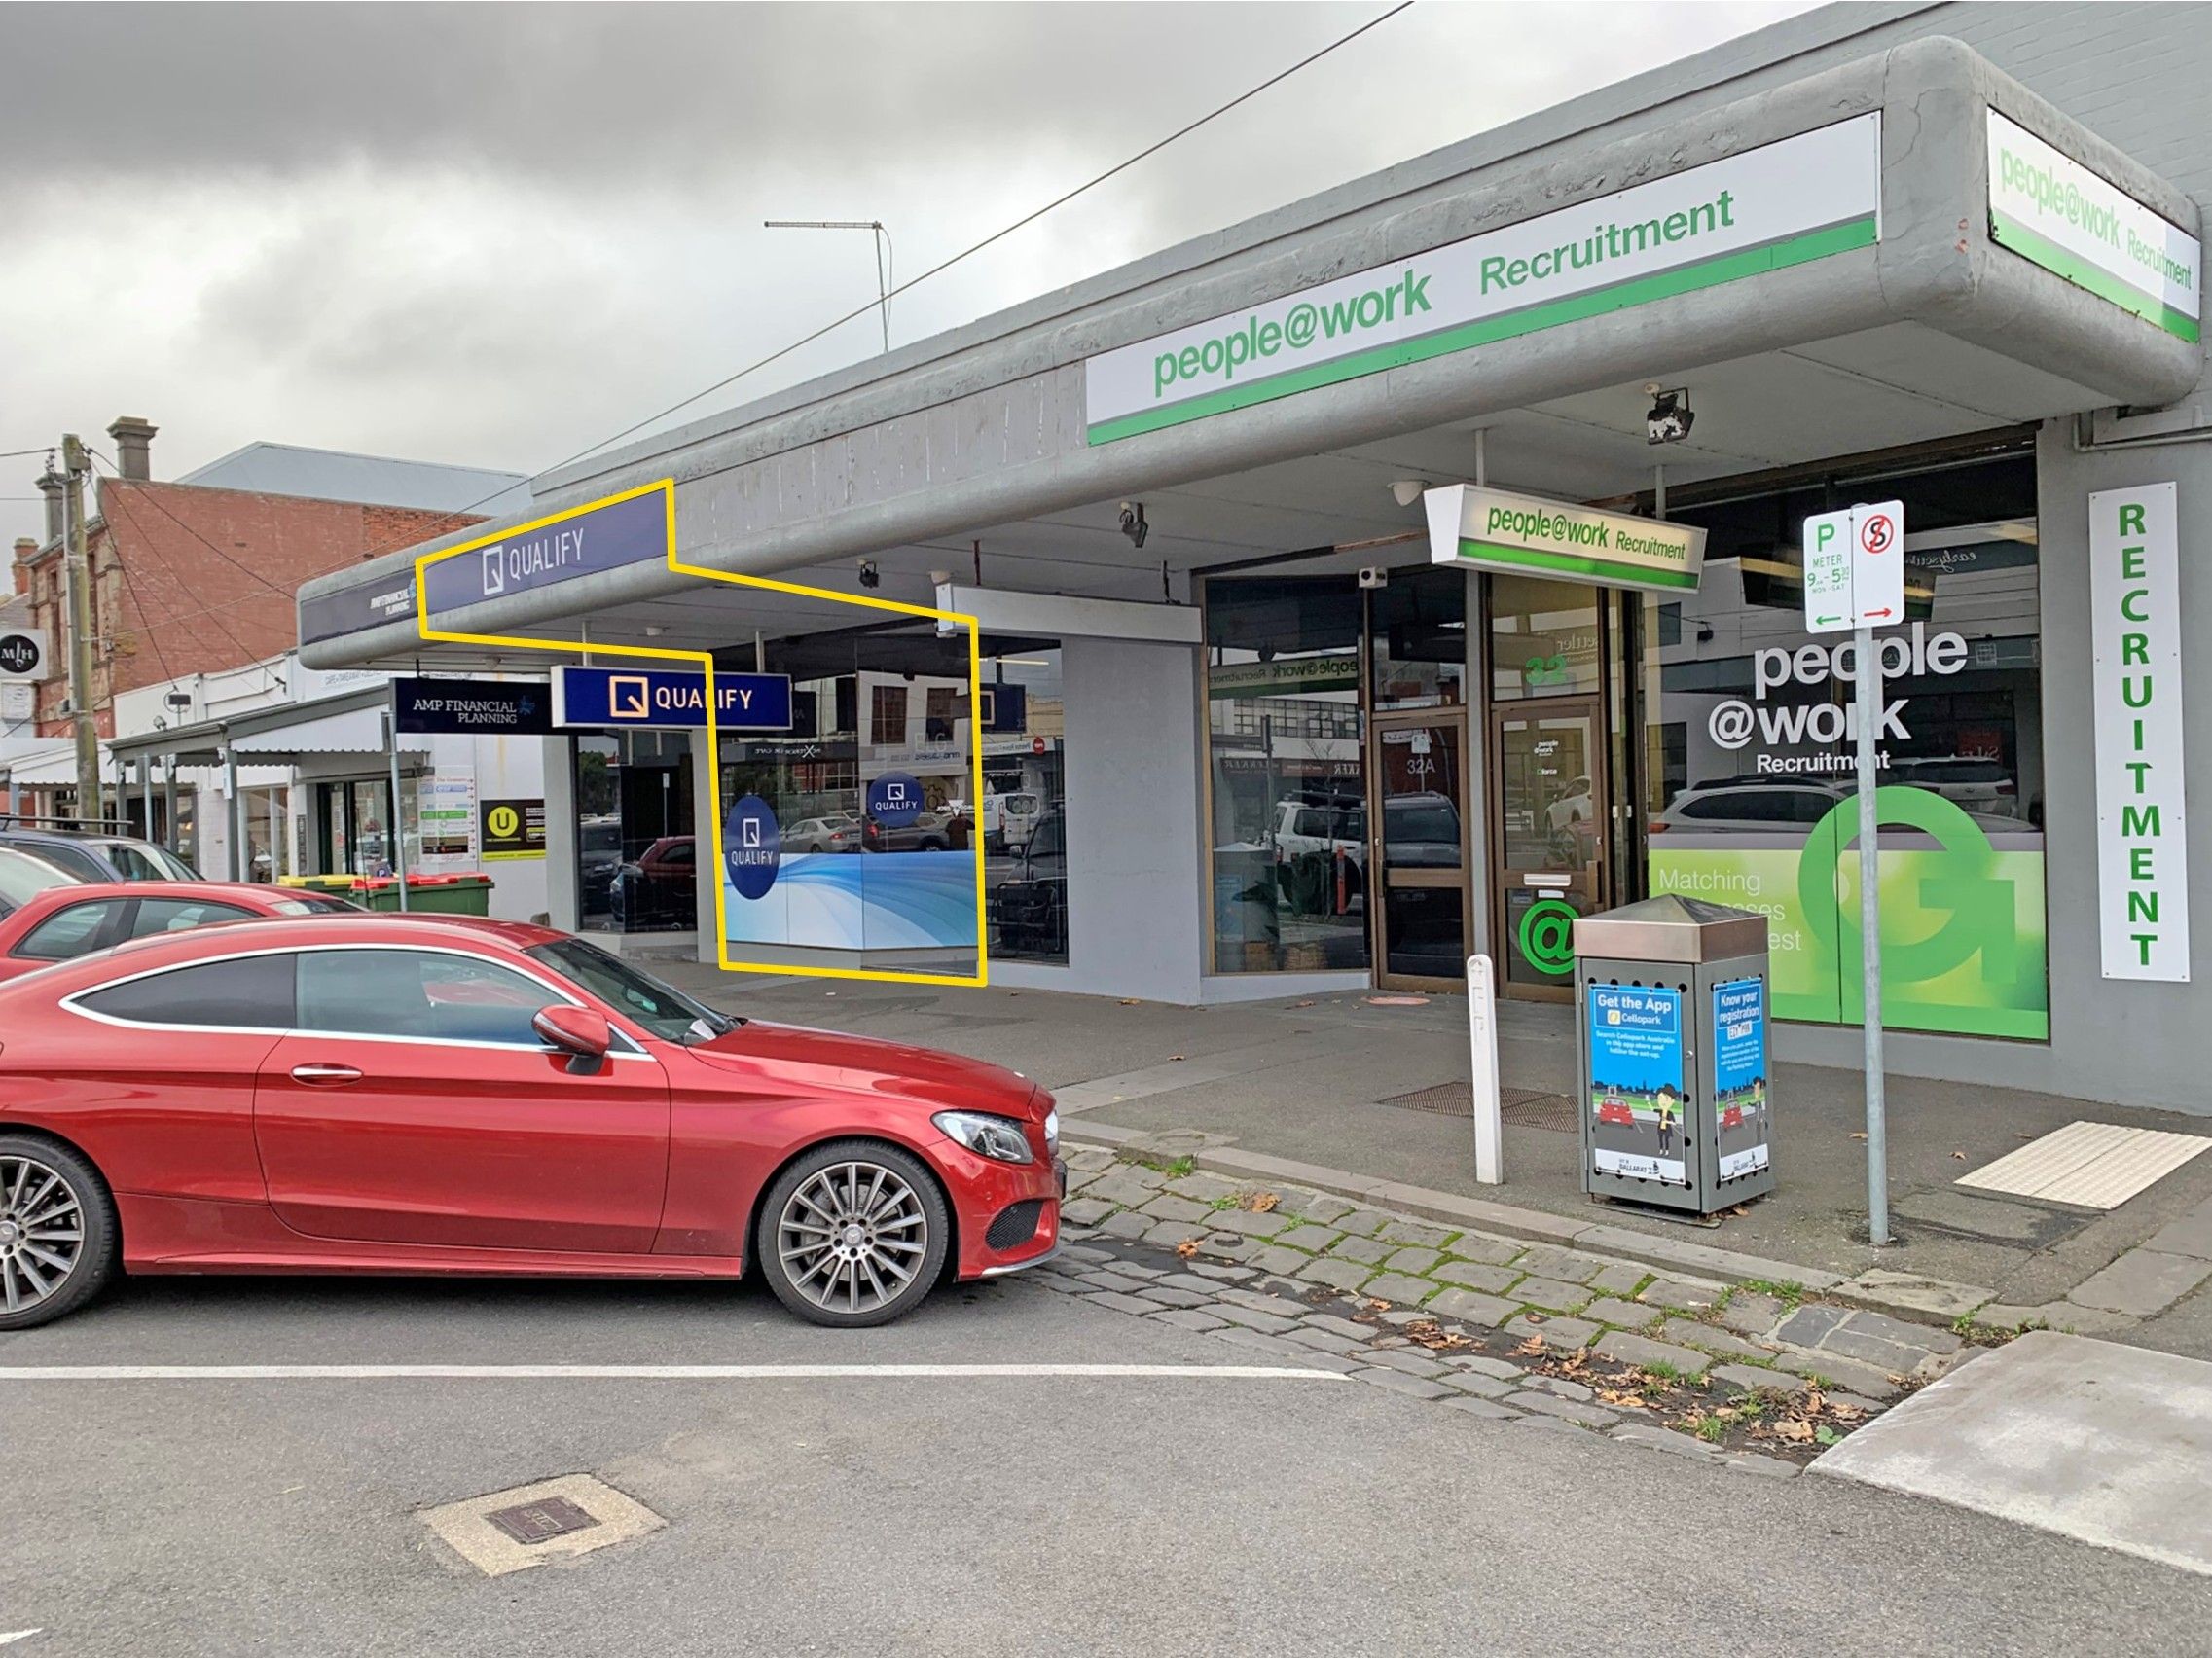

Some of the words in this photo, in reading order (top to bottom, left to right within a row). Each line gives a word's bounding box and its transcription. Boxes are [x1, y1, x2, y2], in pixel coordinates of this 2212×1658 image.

[1999, 148, 2121, 249] people@work
[2126, 228, 2192, 290] Recruitment
[1154, 268, 1432, 397] people@work
[1479, 190, 1735, 295] Recruitment
[1487, 505, 1611, 548] people@work
[1615, 530, 1686, 559] Recruitment
[1817, 523, 1835, 552] P
[508, 527, 585, 581] QUALIFY
[1812, 554, 1842, 568] METER
[1525, 654, 1568, 685] 32
[1754, 621, 1969, 700] people
[413, 699, 444, 711] AMP
[445, 700, 517, 713] FINANCIAL
[655, 686, 753, 710] QUAIFY
[457, 713, 518, 724] PLANNING
[2118, 502, 2161, 967] RECRUITMENT
[1406, 758, 1435, 775] 32A
[1756, 749, 1891, 773] Recruitmnt
[875, 800, 918, 811] QUALIFY
[731, 850, 774, 866] QUALIFY
[1658, 868, 1761, 896] Matching
[1768, 930, 1802, 951] est
[1597, 994, 1619, 1008] Get
[1621, 996, 1643, 1009] the
[1645, 997, 1672, 1014] App
[1720, 993, 1741, 1008] Know
[1742, 992, 1758, 1006] your
[1621, 1013, 1662, 1025] Cellopark
[1719, 1006, 1759, 1025] registration
